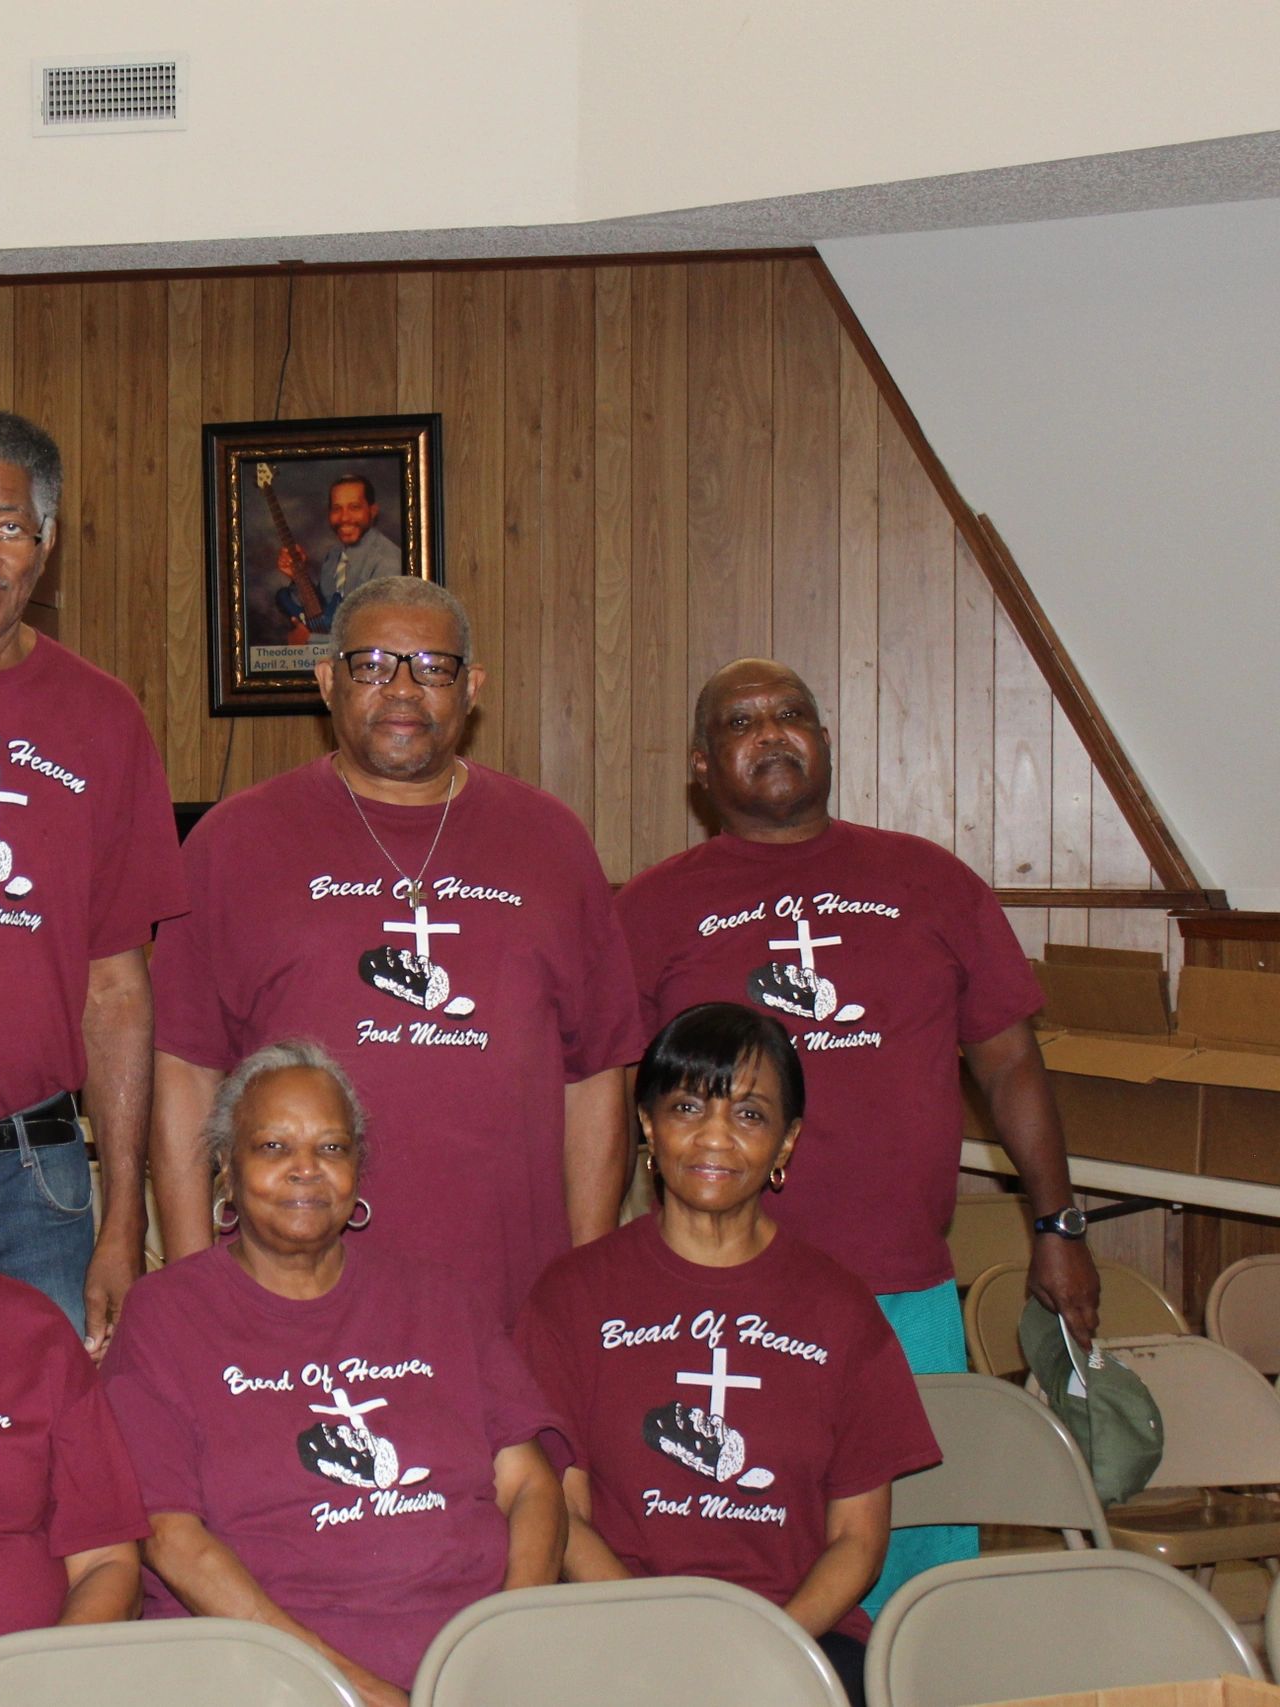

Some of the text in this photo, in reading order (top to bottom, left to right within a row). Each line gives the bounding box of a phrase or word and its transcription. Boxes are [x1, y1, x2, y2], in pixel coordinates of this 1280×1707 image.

[254, 660, 277, 671] April
[256, 647, 304, 657] Theodore
[8, 740, 87, 794] Heaven
[309, 875, 383, 900] Bread
[433, 876, 523, 907] Heaven
[698, 892, 901, 937] Bread Of Heaven
[356, 1019, 489, 1050] Food Ministry
[804, 1030, 882, 1051] Ministry
[601, 1309, 828, 1365] Bread Of Heaven
[223, 1357, 434, 1395] Bread Of Heaven
[311, 1490, 447, 1532] Food Ministry
[642, 1489, 786, 1527] Food Ministry
